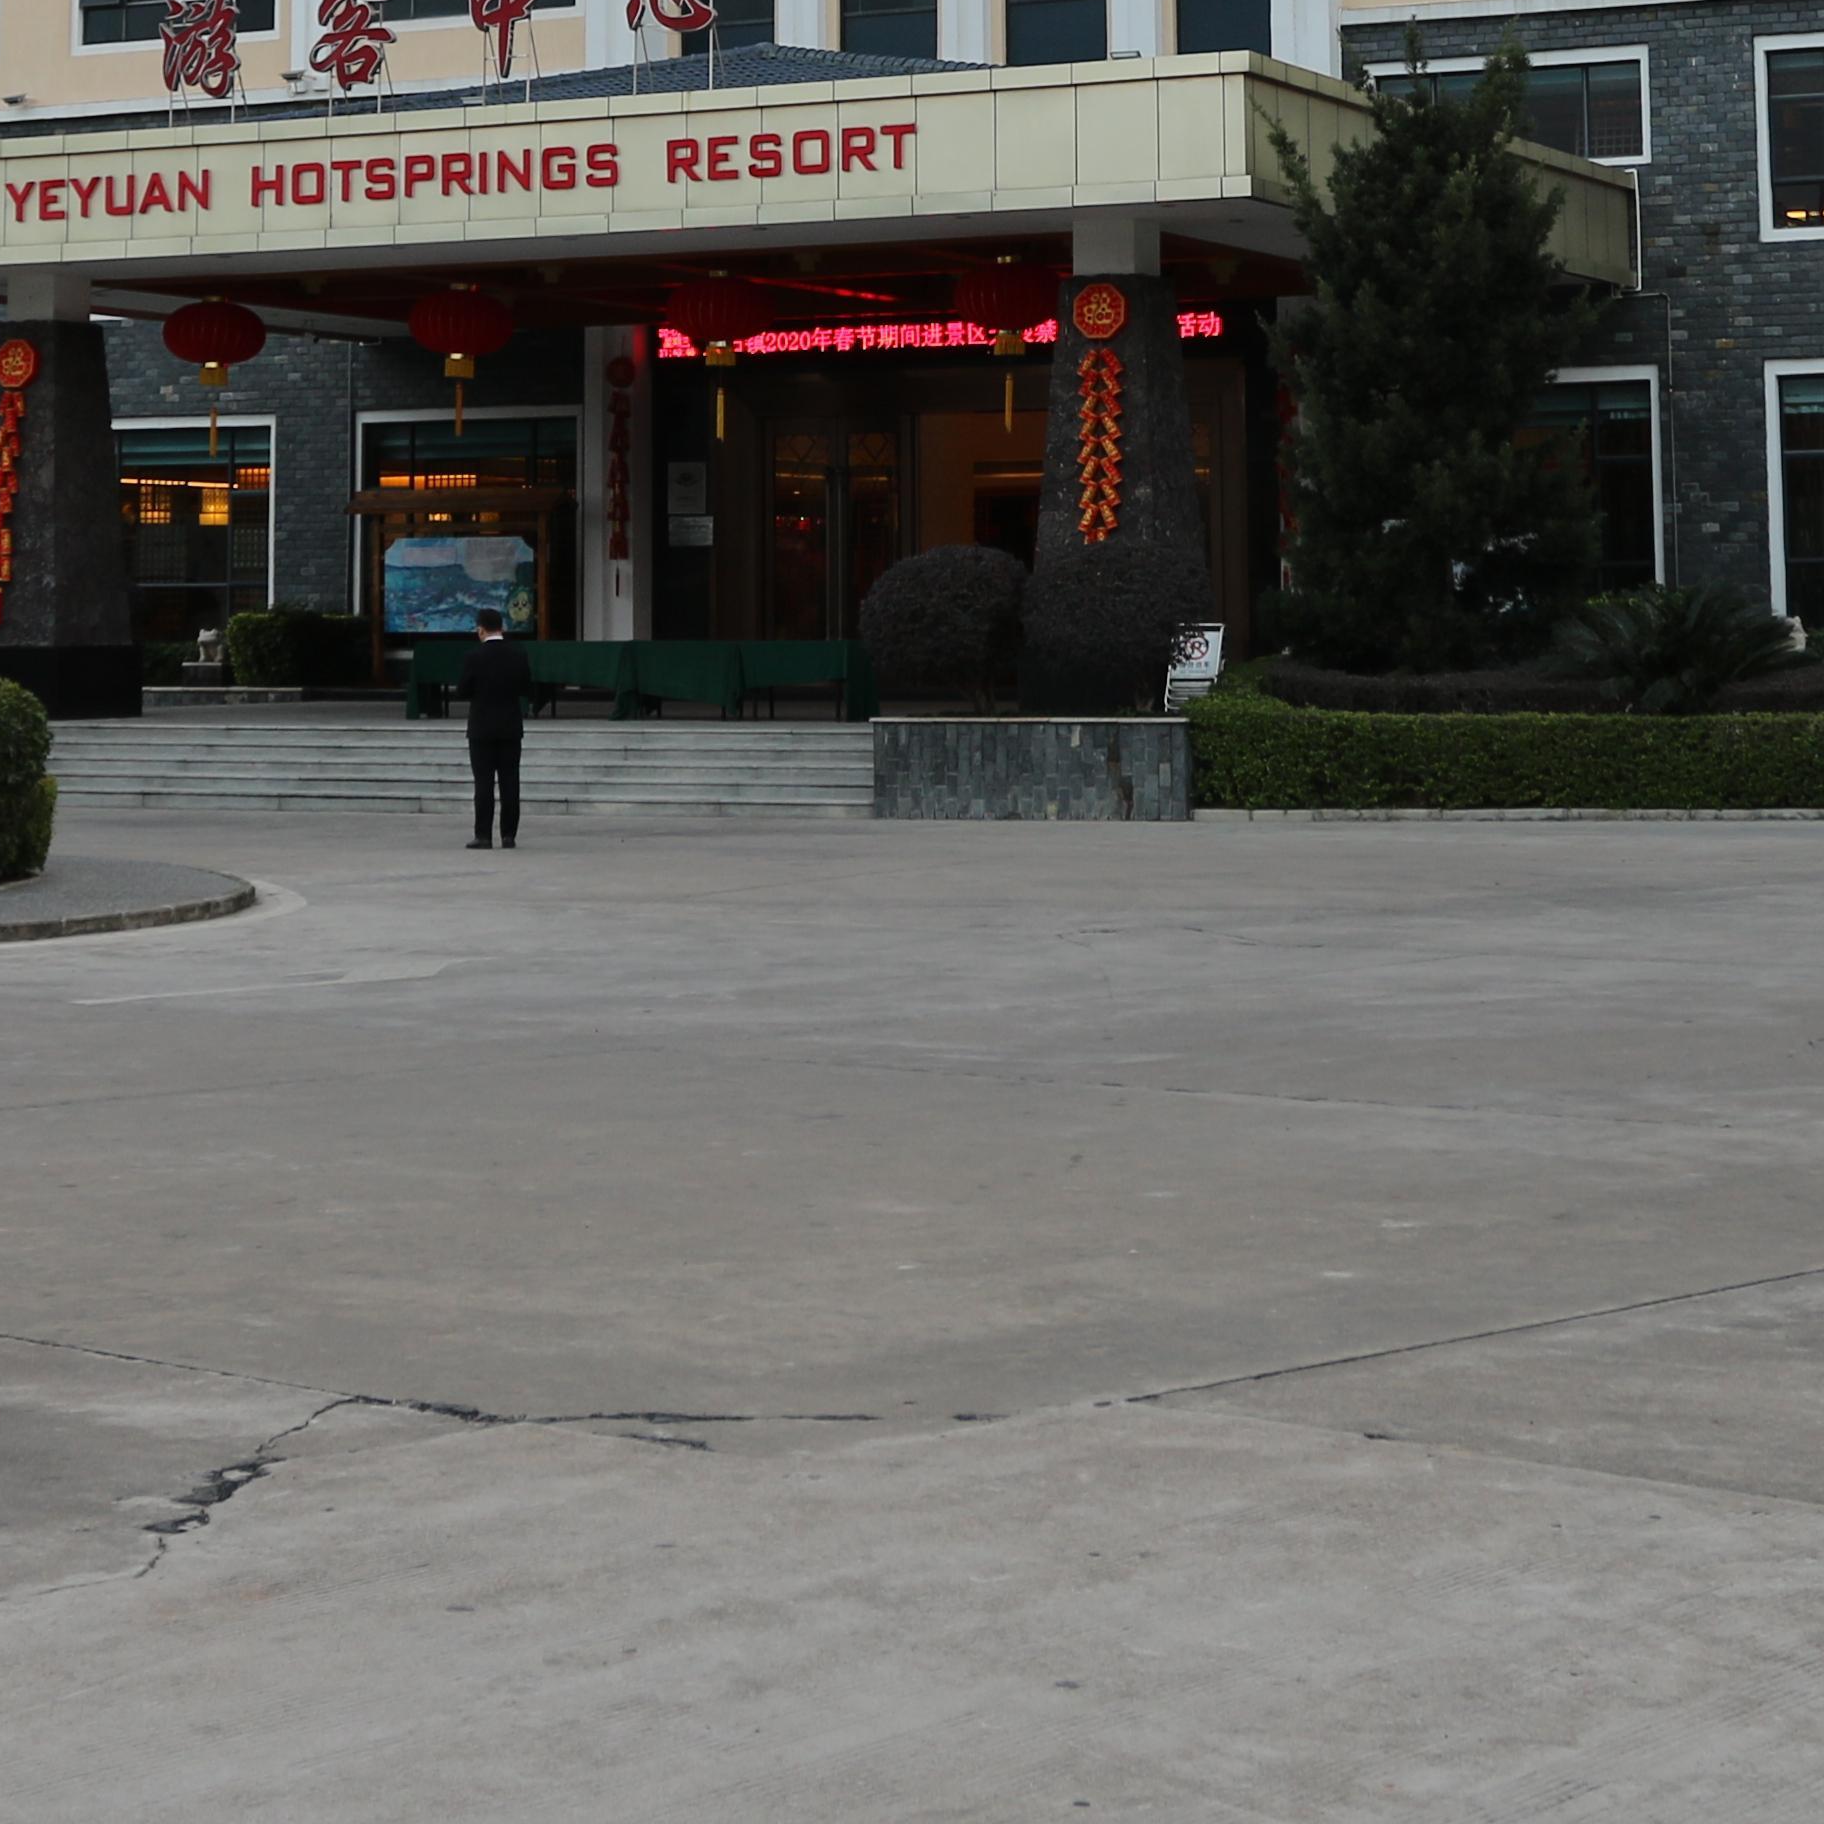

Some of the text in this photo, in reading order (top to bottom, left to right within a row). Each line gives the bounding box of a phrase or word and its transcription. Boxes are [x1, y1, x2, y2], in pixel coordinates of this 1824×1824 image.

[5, 123, 917, 223] YEYUAN HOTSPRINGS RESORT
